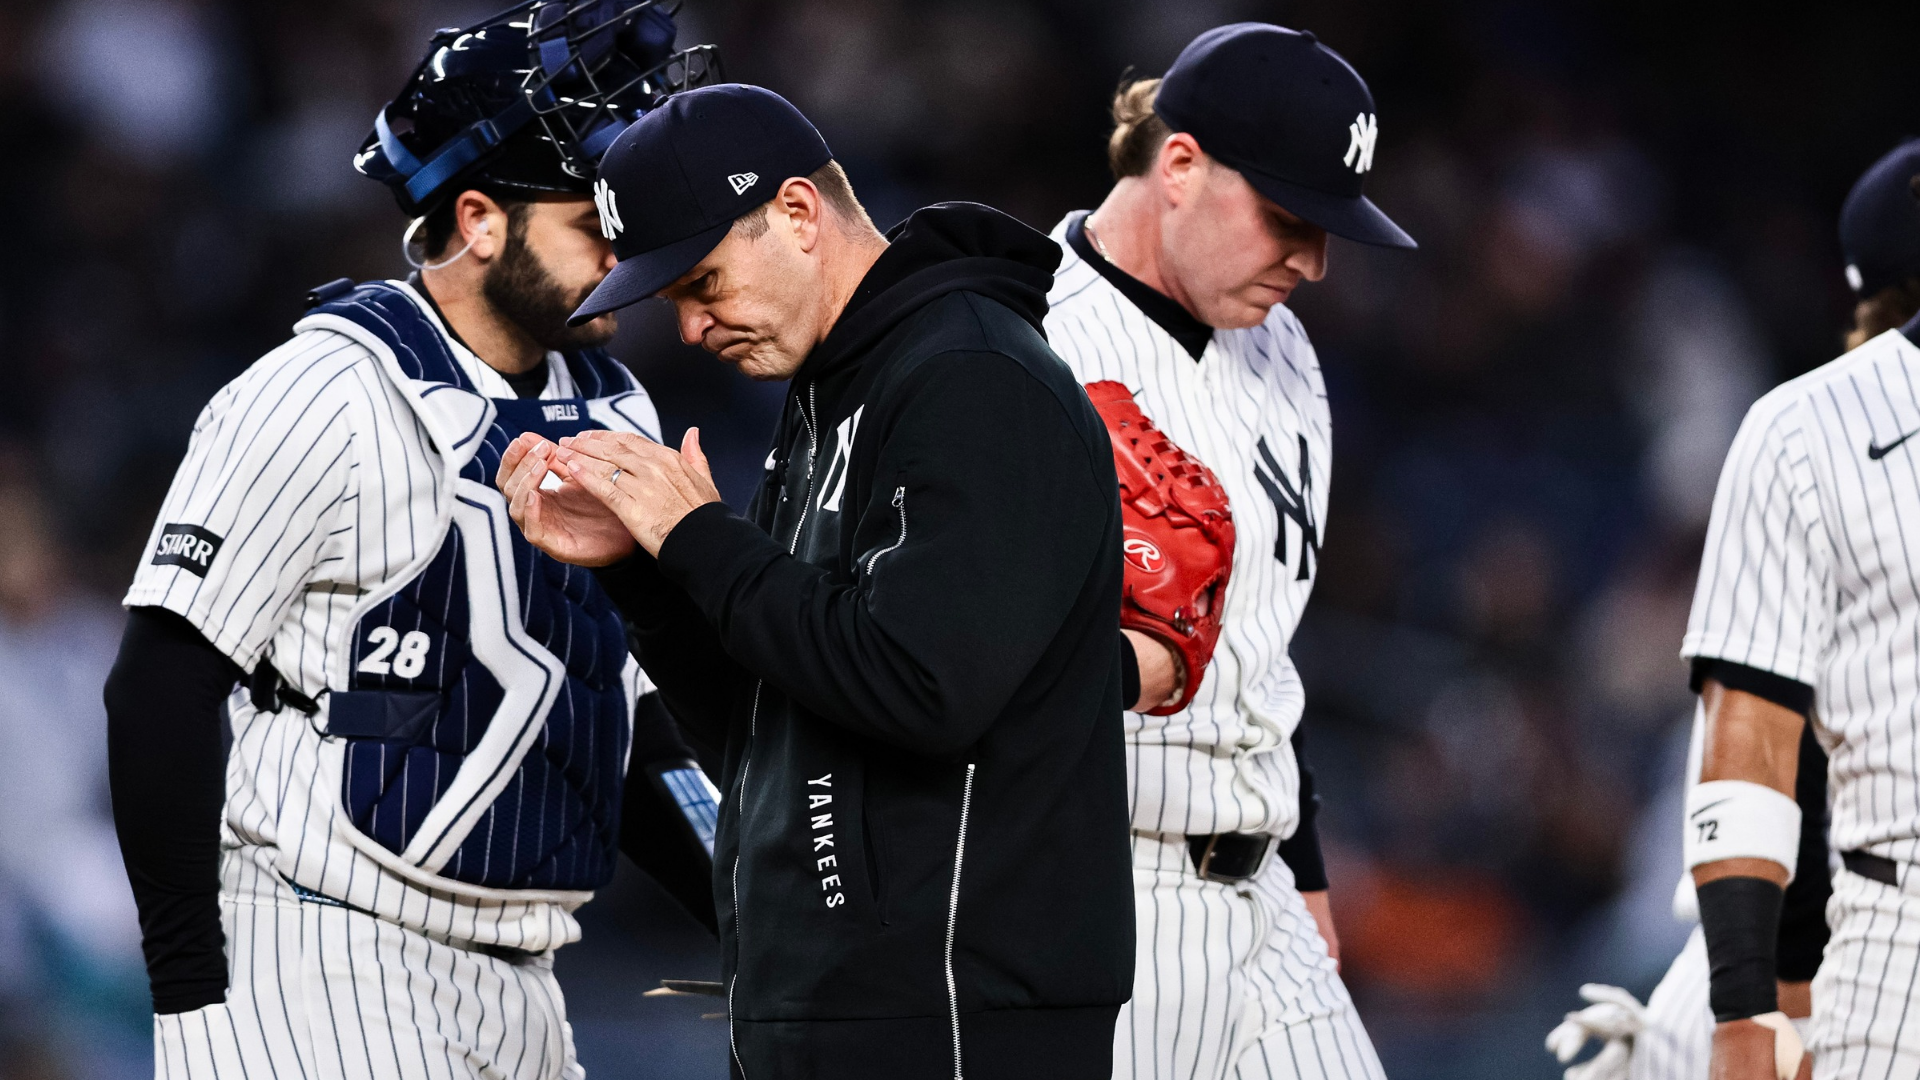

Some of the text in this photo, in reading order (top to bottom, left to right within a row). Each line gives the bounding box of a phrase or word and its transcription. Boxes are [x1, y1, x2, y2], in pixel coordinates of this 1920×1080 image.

[1343, 112, 1378, 174] NY
[541, 404, 579, 422] WELLS
[1253, 432, 1322, 581] NY
[157, 533, 214, 567] STARR
[358, 625, 431, 679] 28
[807, 773, 845, 908] YANKEES
